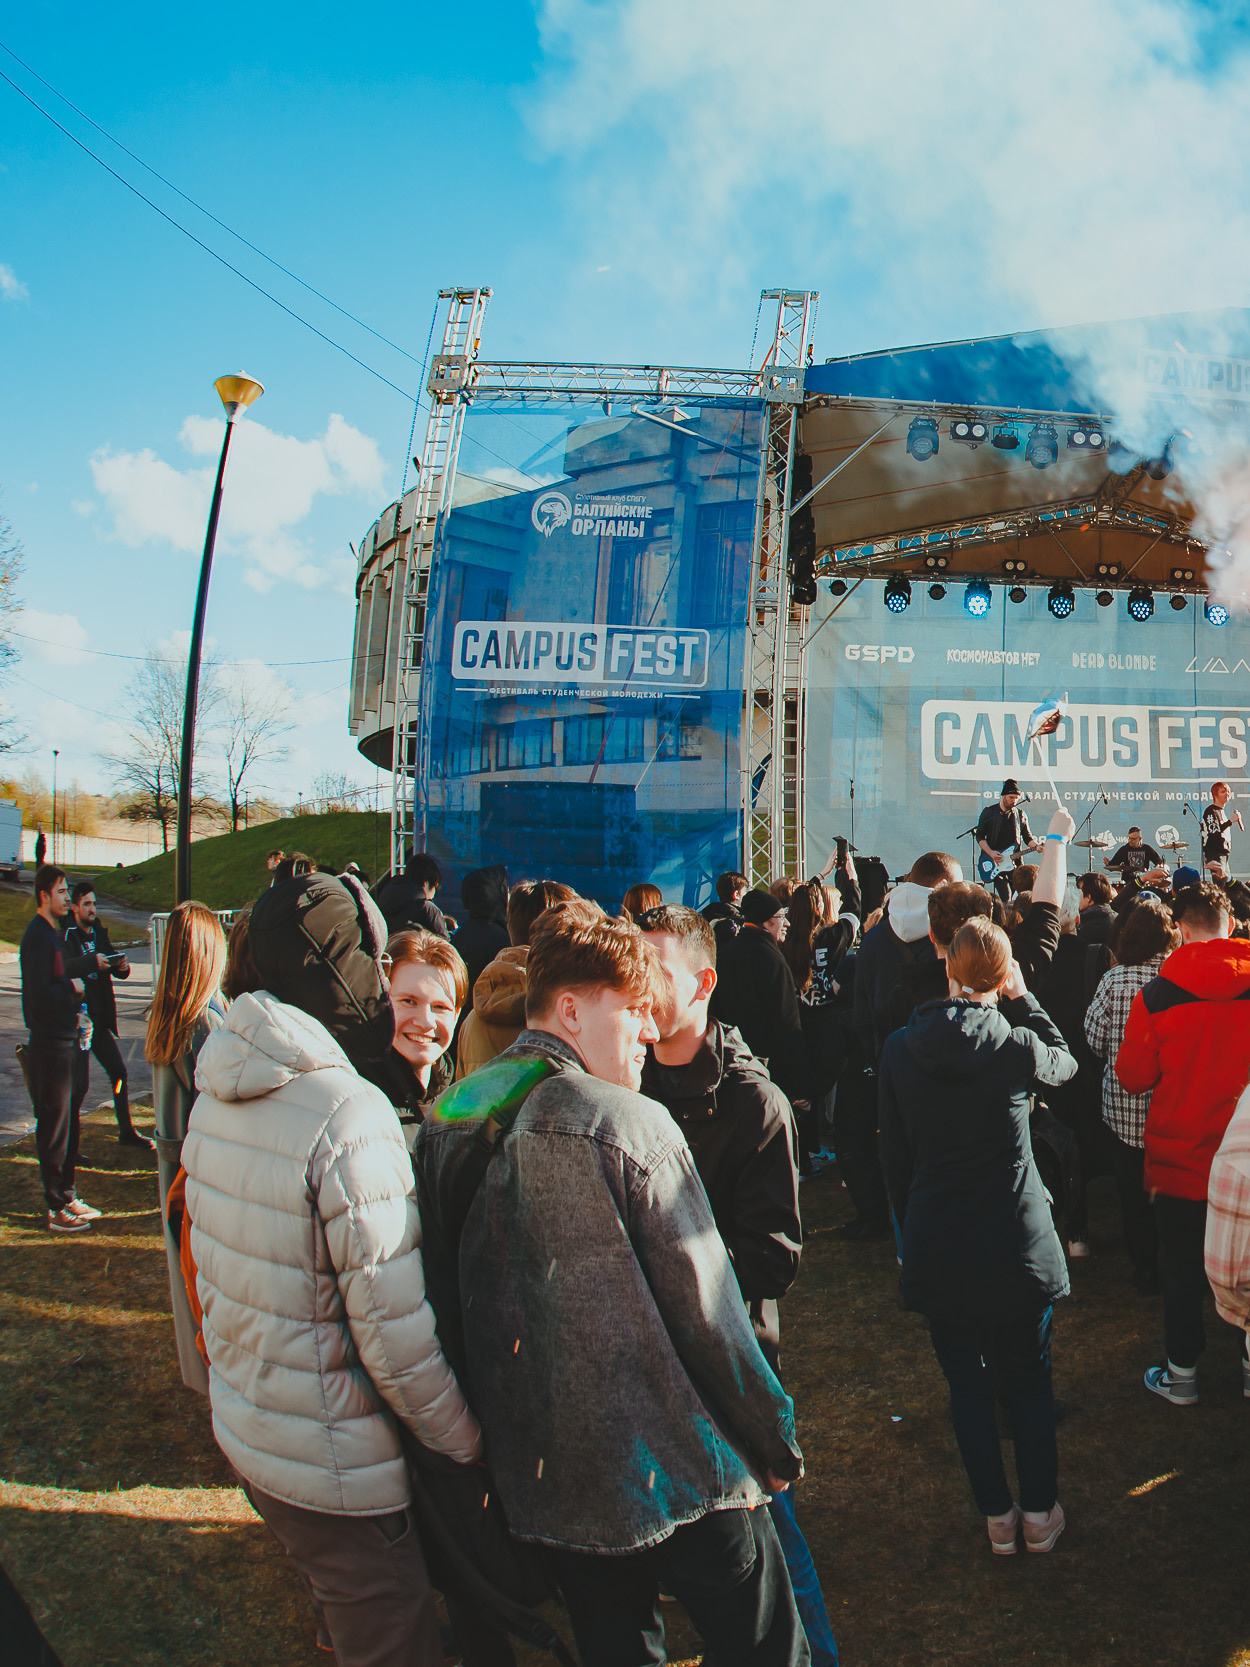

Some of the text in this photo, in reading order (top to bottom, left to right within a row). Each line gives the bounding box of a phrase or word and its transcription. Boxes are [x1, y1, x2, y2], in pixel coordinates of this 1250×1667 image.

[573, 502, 654, 519] БАЛТИЙСКИЕ
[571, 518, 646, 538] ОРЛАНЫ
[460, 628, 700, 677] CAMPUS FEST
[844, 643, 916, 664] GSPD
[946, 648, 1041, 668] КОСМОНАВТОВ НЕТ
[1071, 652, 1157, 671] DEAD BLONDE
[489, 687, 663, 700] ФЕСТИВАЛЬ СТУДЕНЧЕСКОЙ МОЛОДЕЖИ
[933, 711, 1139, 768] CAMPUS
[1064, 790, 1160, 802] СТУДЕНЧЕСКОЙ
[1165, 791, 1235, 802] МОЛОДИ
